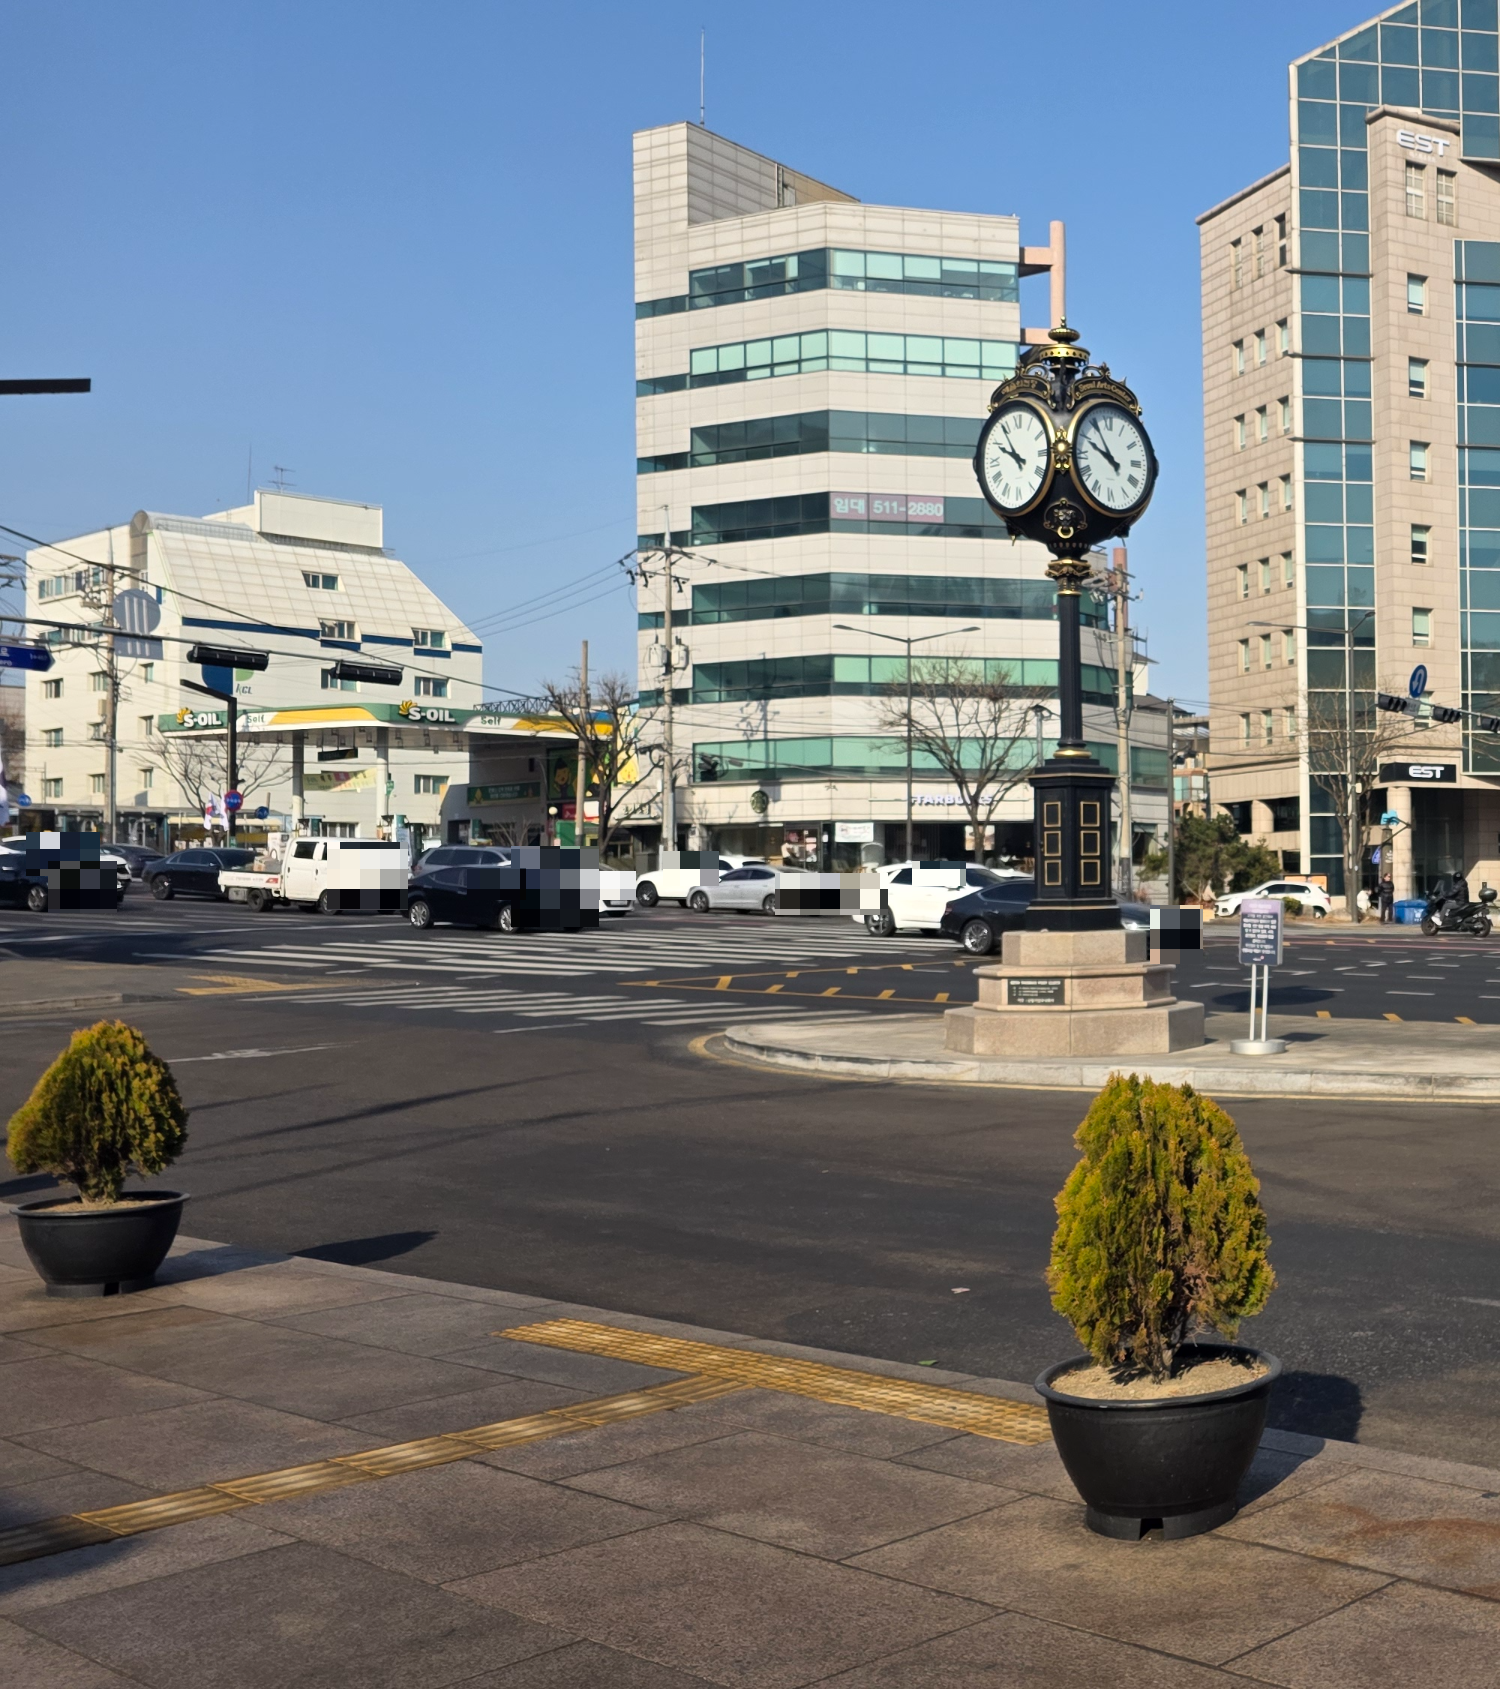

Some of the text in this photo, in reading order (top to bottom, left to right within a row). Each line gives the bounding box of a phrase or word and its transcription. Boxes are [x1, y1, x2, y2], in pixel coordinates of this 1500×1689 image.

[1397, 129, 1450, 157] EST
[834, 498, 944, 516] 임대 511-2880
[183, 712, 222, 728] S-OIL
[247, 713, 265, 723] Self
[408, 707, 455, 722] S-OIL
[480, 716, 501, 726] Self
[1408, 765, 1444, 778] EST
